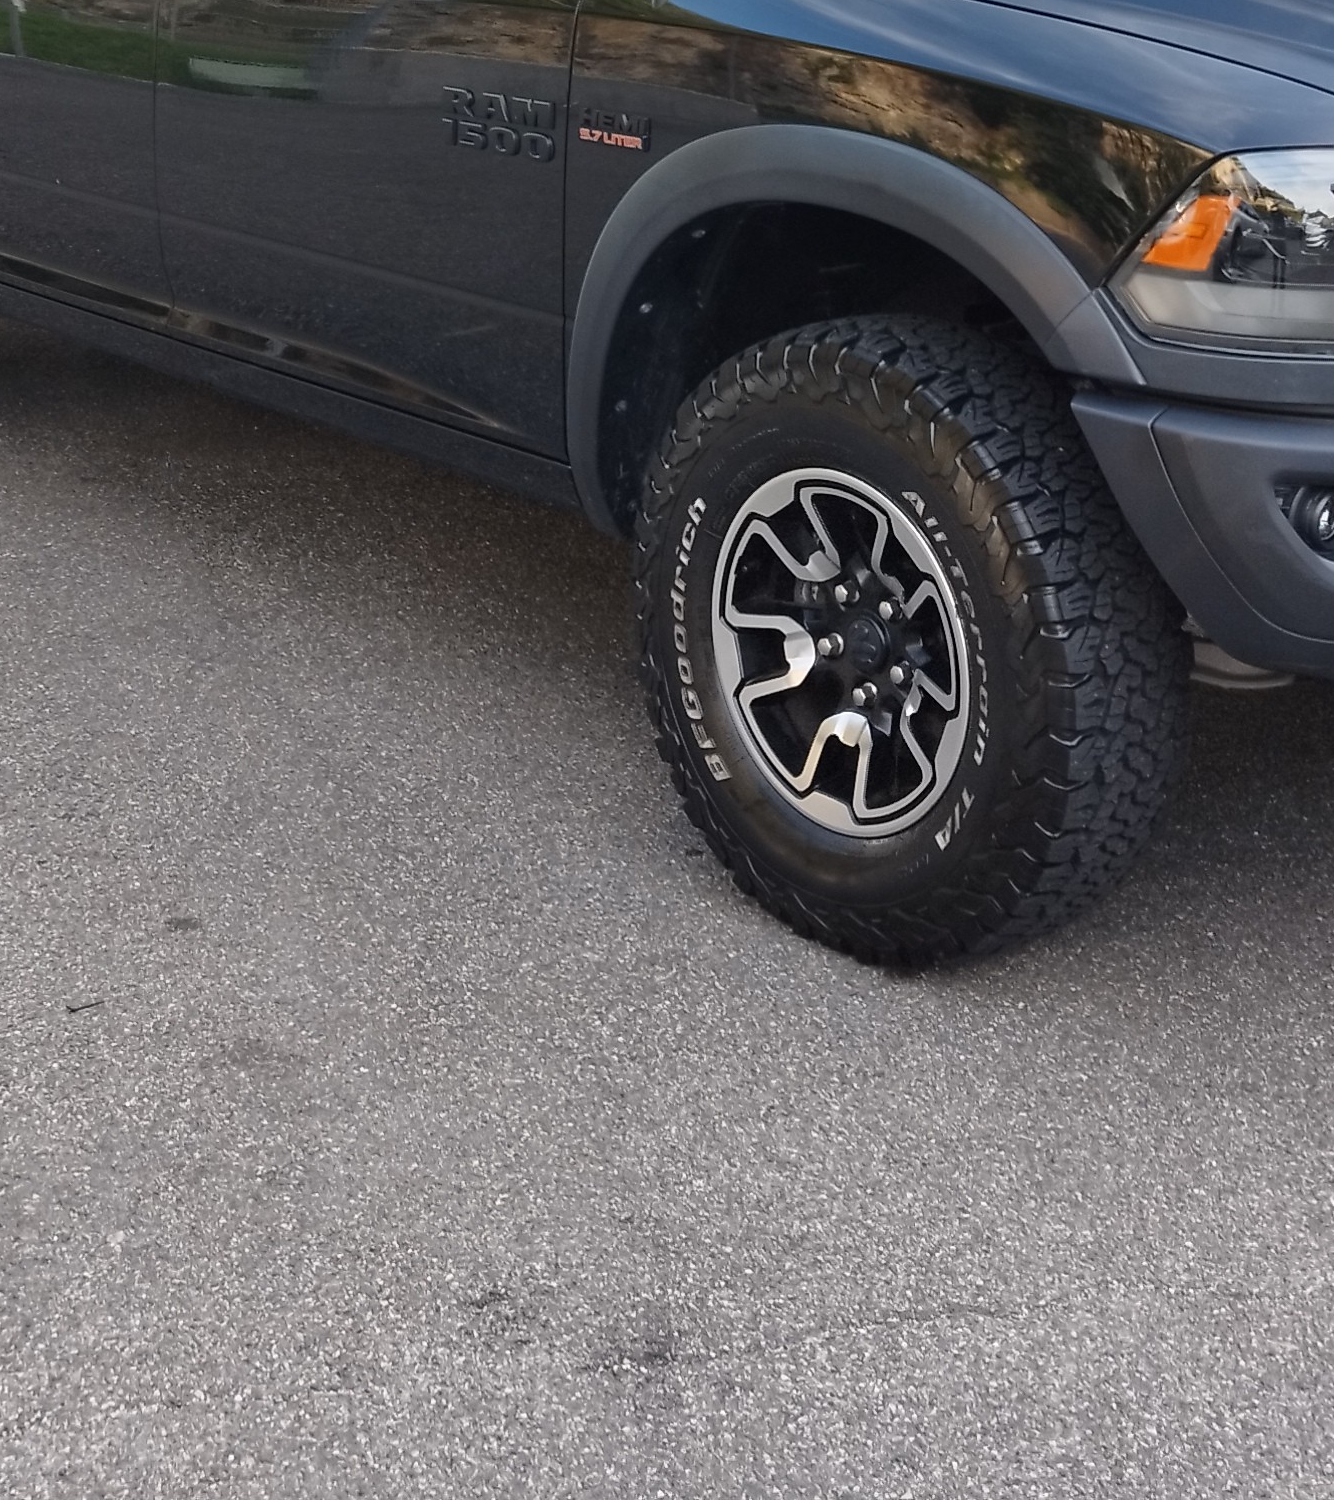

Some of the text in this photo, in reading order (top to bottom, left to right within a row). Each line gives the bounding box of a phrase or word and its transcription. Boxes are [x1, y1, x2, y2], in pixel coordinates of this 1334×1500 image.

[442, 85, 556, 131] RAM
[581, 108, 651, 134] HEMI
[441, 117, 556, 163] 1500
[603, 130, 643, 150] LITER
[670, 497, 732, 782] BFGoodrich
[901, 490, 990, 766] All-Terrain
